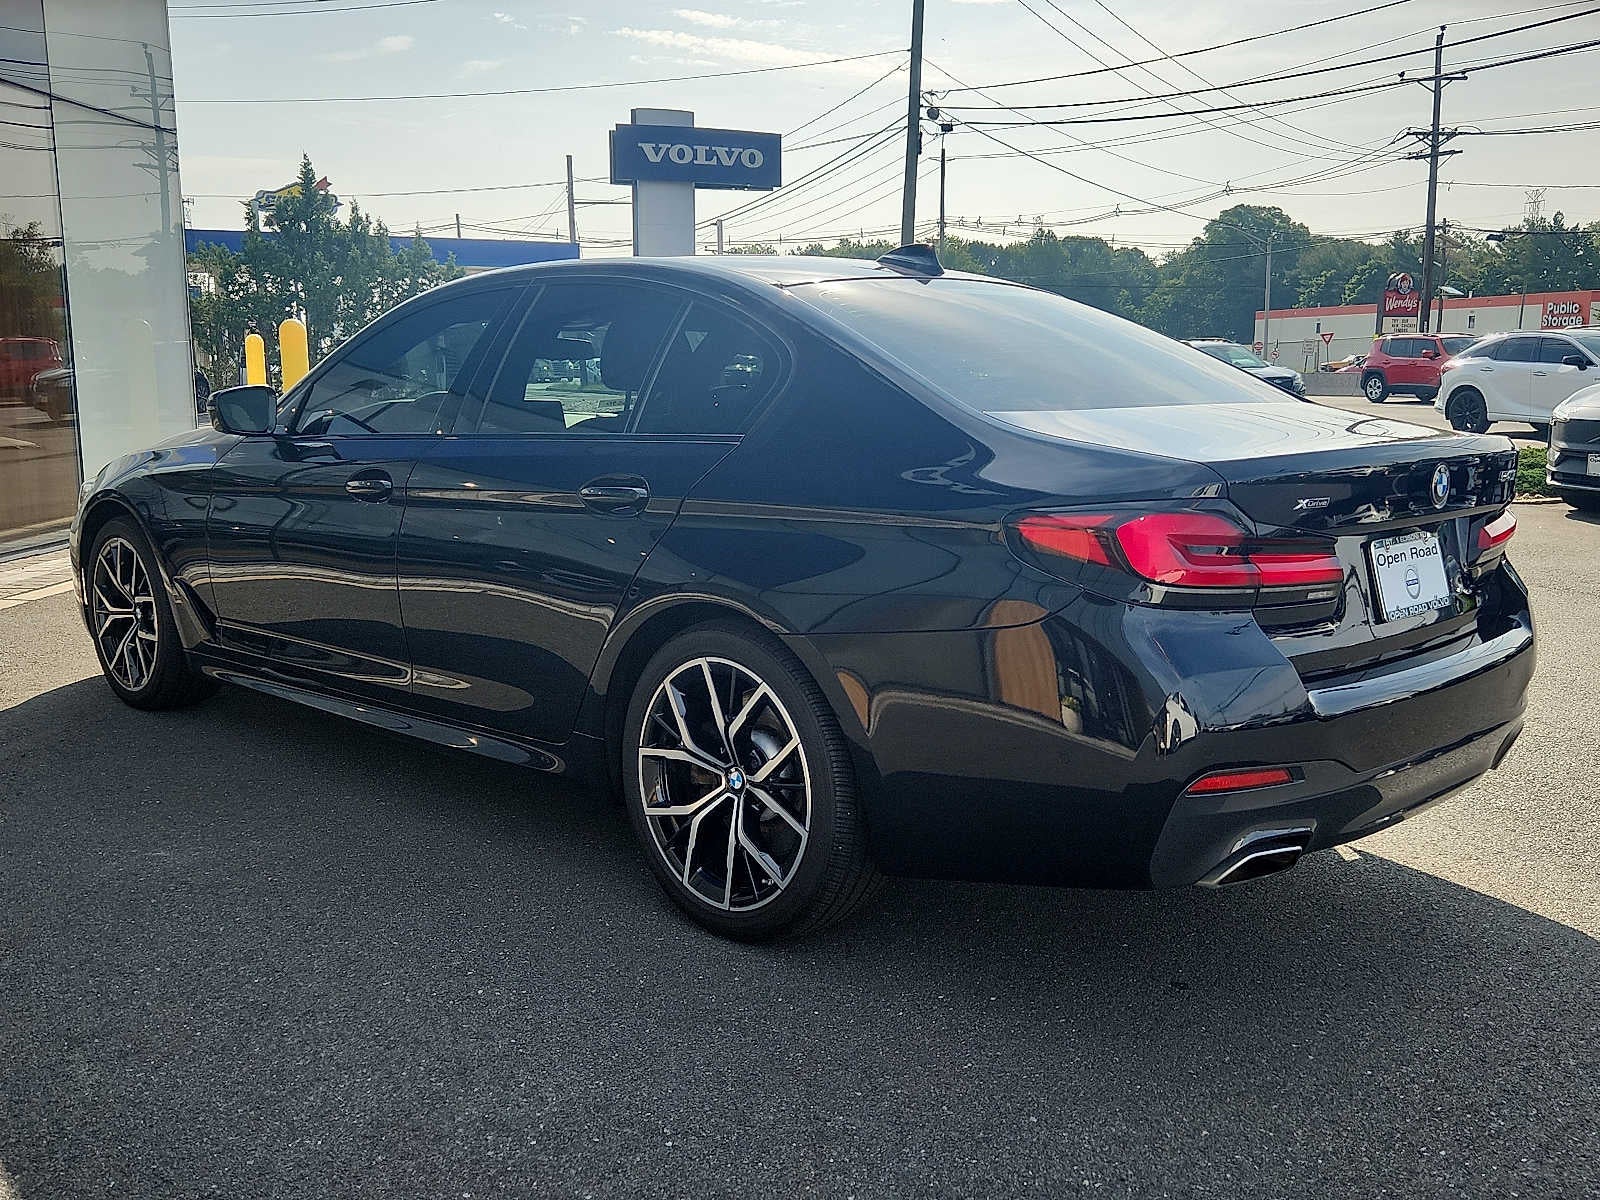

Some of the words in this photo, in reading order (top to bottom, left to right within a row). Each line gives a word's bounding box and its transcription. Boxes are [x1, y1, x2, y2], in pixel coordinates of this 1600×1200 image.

[638, 143, 764, 168] VOLVO
[1385, 294, 1418, 311] Wendy's
[1546, 300, 1580, 315] Public
[1541, 314, 1583, 327] Storage
[1377, 551, 1407, 568] Open
[1409, 543, 1438, 560] Road
[1409, 603, 1428, 616] ROAD
